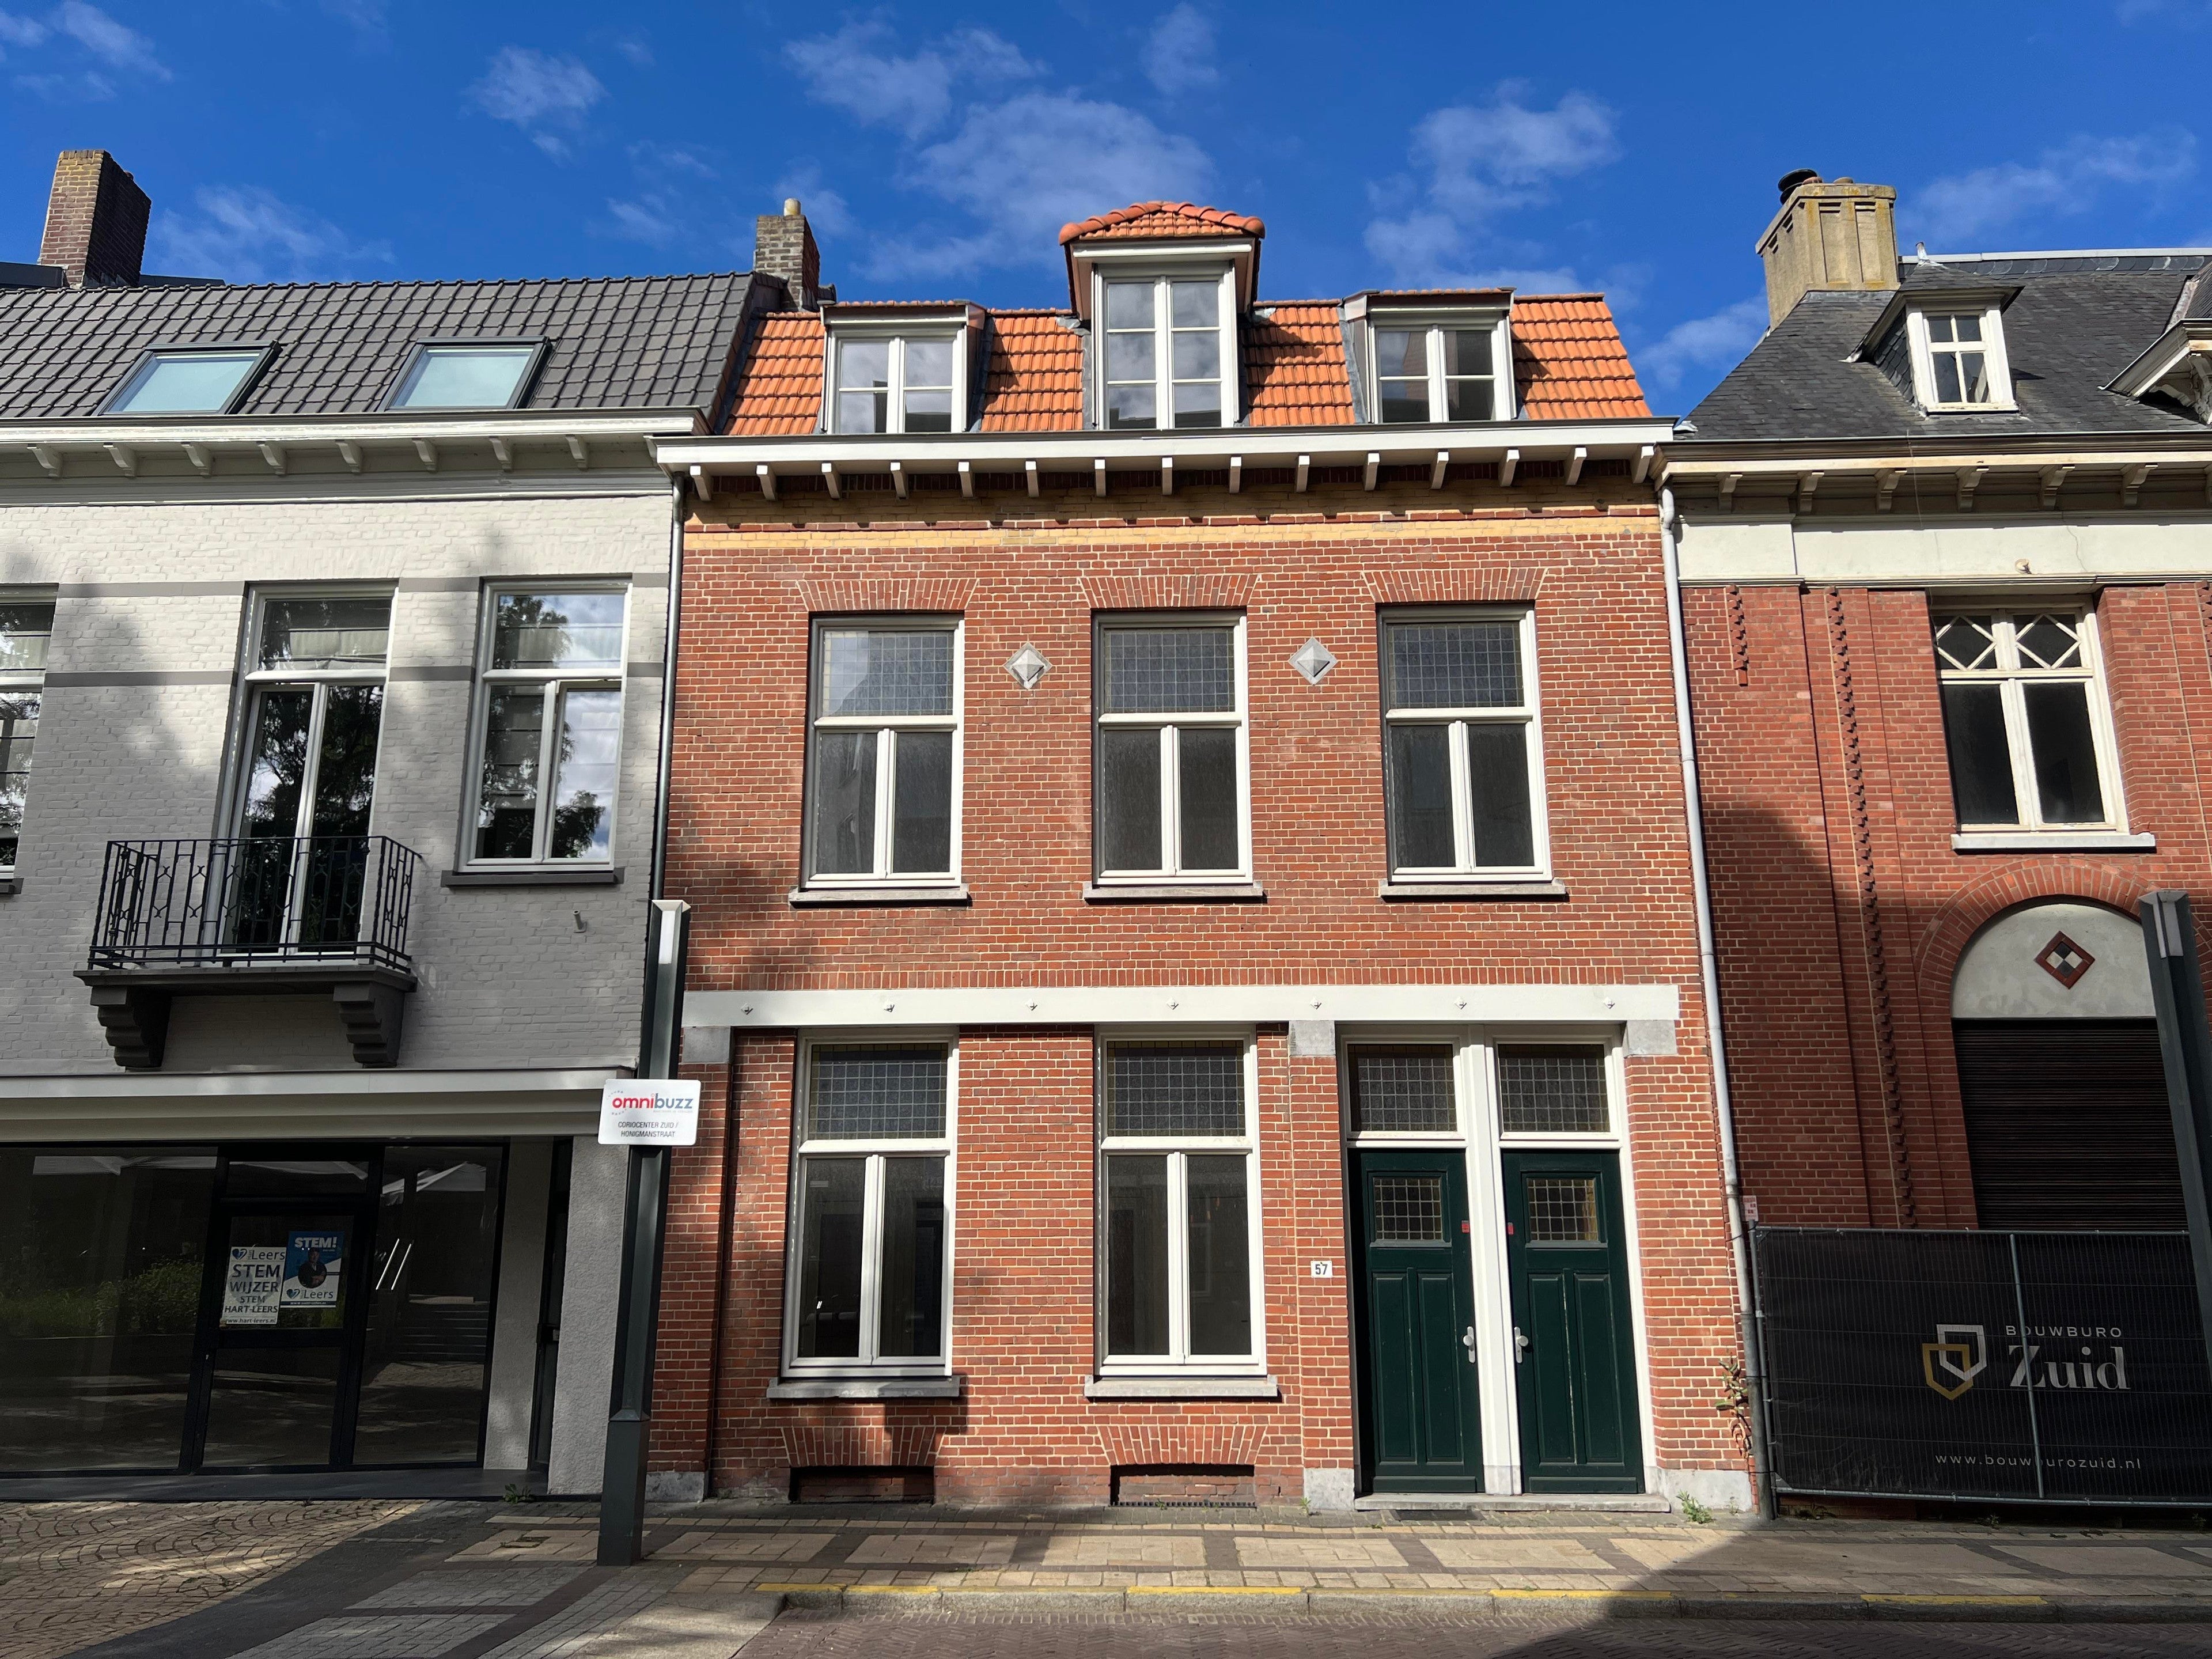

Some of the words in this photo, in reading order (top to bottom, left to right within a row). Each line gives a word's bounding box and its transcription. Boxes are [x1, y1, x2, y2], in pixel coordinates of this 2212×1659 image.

[612, 1093, 694, 1109] omnibuzz
[294, 1237, 338, 1248] STEM!
[252, 1249, 285, 1260] Leers
[232, 1264, 281, 1278] STEM
[1315, 1264, 1328, 1275] 57
[230, 1282, 279, 1294] WIJZER
[304, 1289, 334, 1299] Leers
[2008, 1345, 2131, 1389] Zuid
